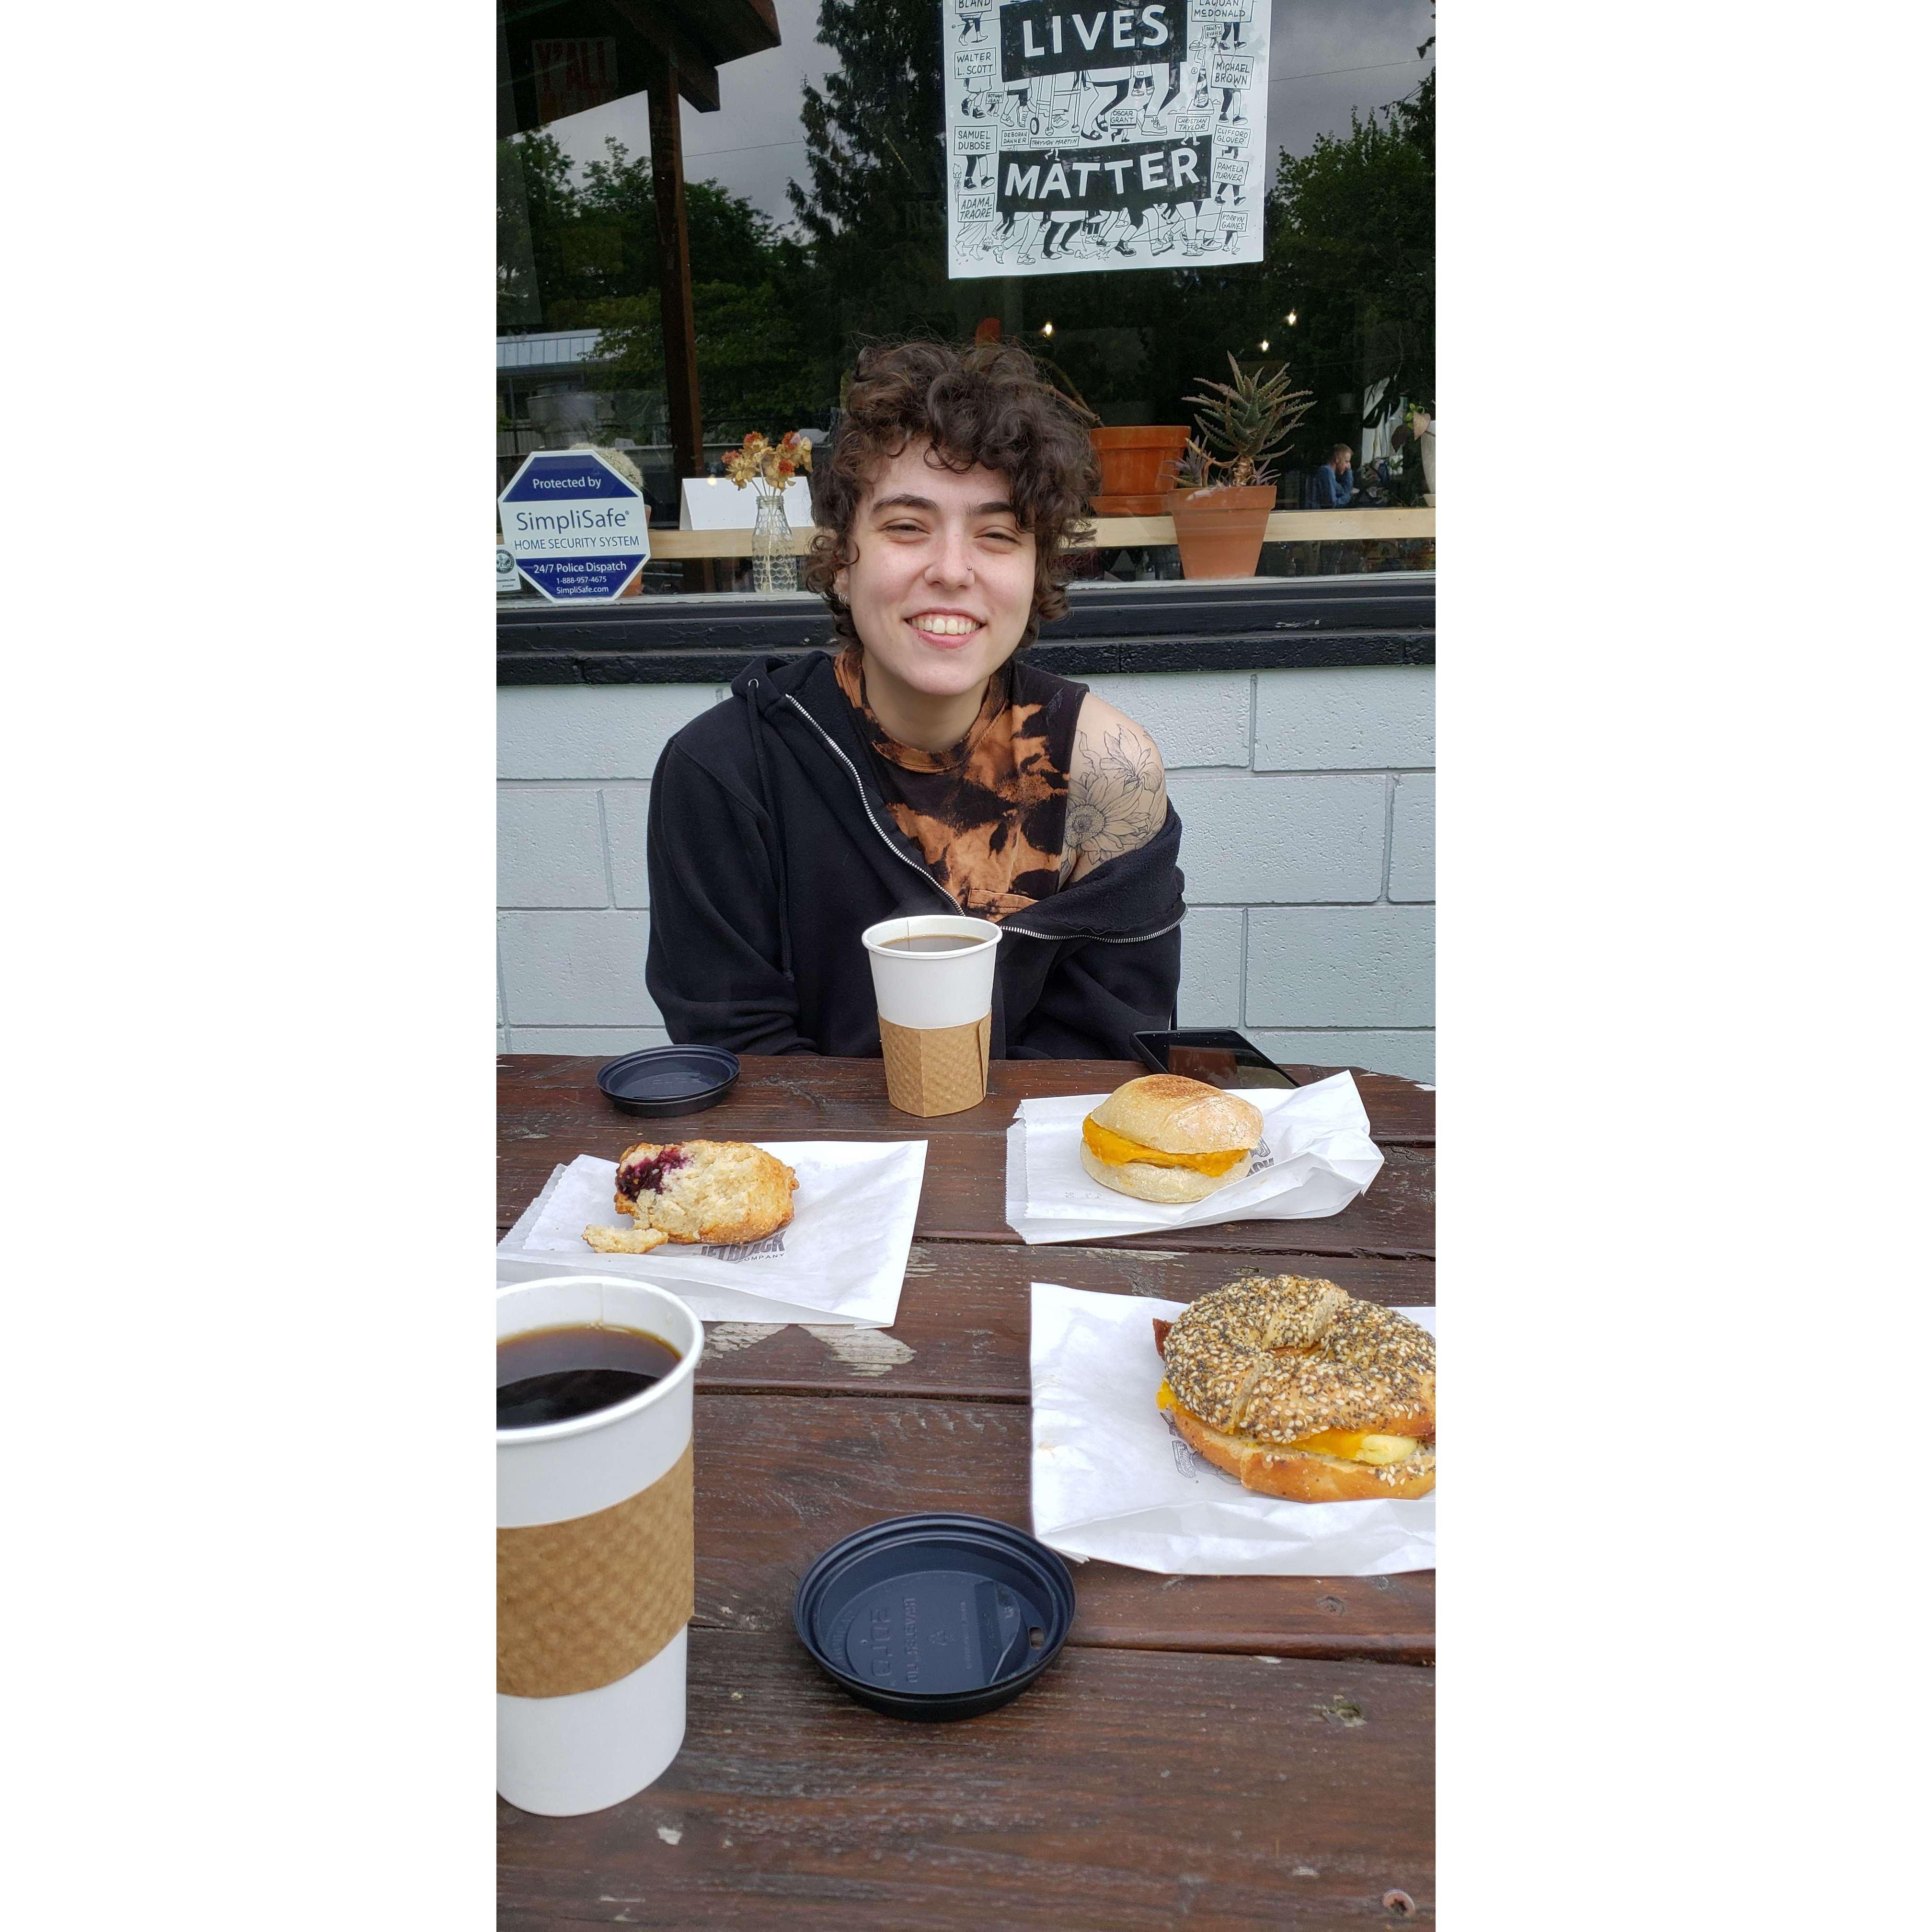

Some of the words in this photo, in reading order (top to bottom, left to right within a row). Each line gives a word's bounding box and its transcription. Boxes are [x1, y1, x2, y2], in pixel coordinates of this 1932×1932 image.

[959, 0, 990, 8] BLAND
[1023, 4, 1168, 58] LIVES
[957, 52, 991, 62] WALTER
[957, 67, 965, 76] L.
[966, 64, 993, 75] SCOTT
[1216, 62, 1250, 73] MICHAEL
[1215, 73, 1247, 85] BROWN
[958, 130, 991, 139] SAMUEL
[1218, 128, 1248, 138] CLIFFORD
[958, 141, 990, 150] DUBOSE
[1217, 136, 1244, 145] GLOVER
[1218, 162, 1243, 173] PAMELA
[1005, 148, 1200, 199] MATTER
[1216, 172, 1242, 182] TURNER
[961, 196, 989, 210] ADAMA
[1222, 214, 1245, 223] KORRYN
[1222, 221, 1244, 230] GAINES
[532, 477, 585, 489] Protected
[588, 476, 601, 489] by
[515, 539, 545, 550] HOME
[549, 538, 597, 549] SECURITY
[600, 536, 640, 547] SYSTEM
[533, 564, 553, 574] 24/7
[556, 563, 584, 573] Police
[586, 561, 627, 574] Dispatch
[556, 586, 609, 595] SimpliSafe.com
[744, 1253, 784, 1261] OMPANY
